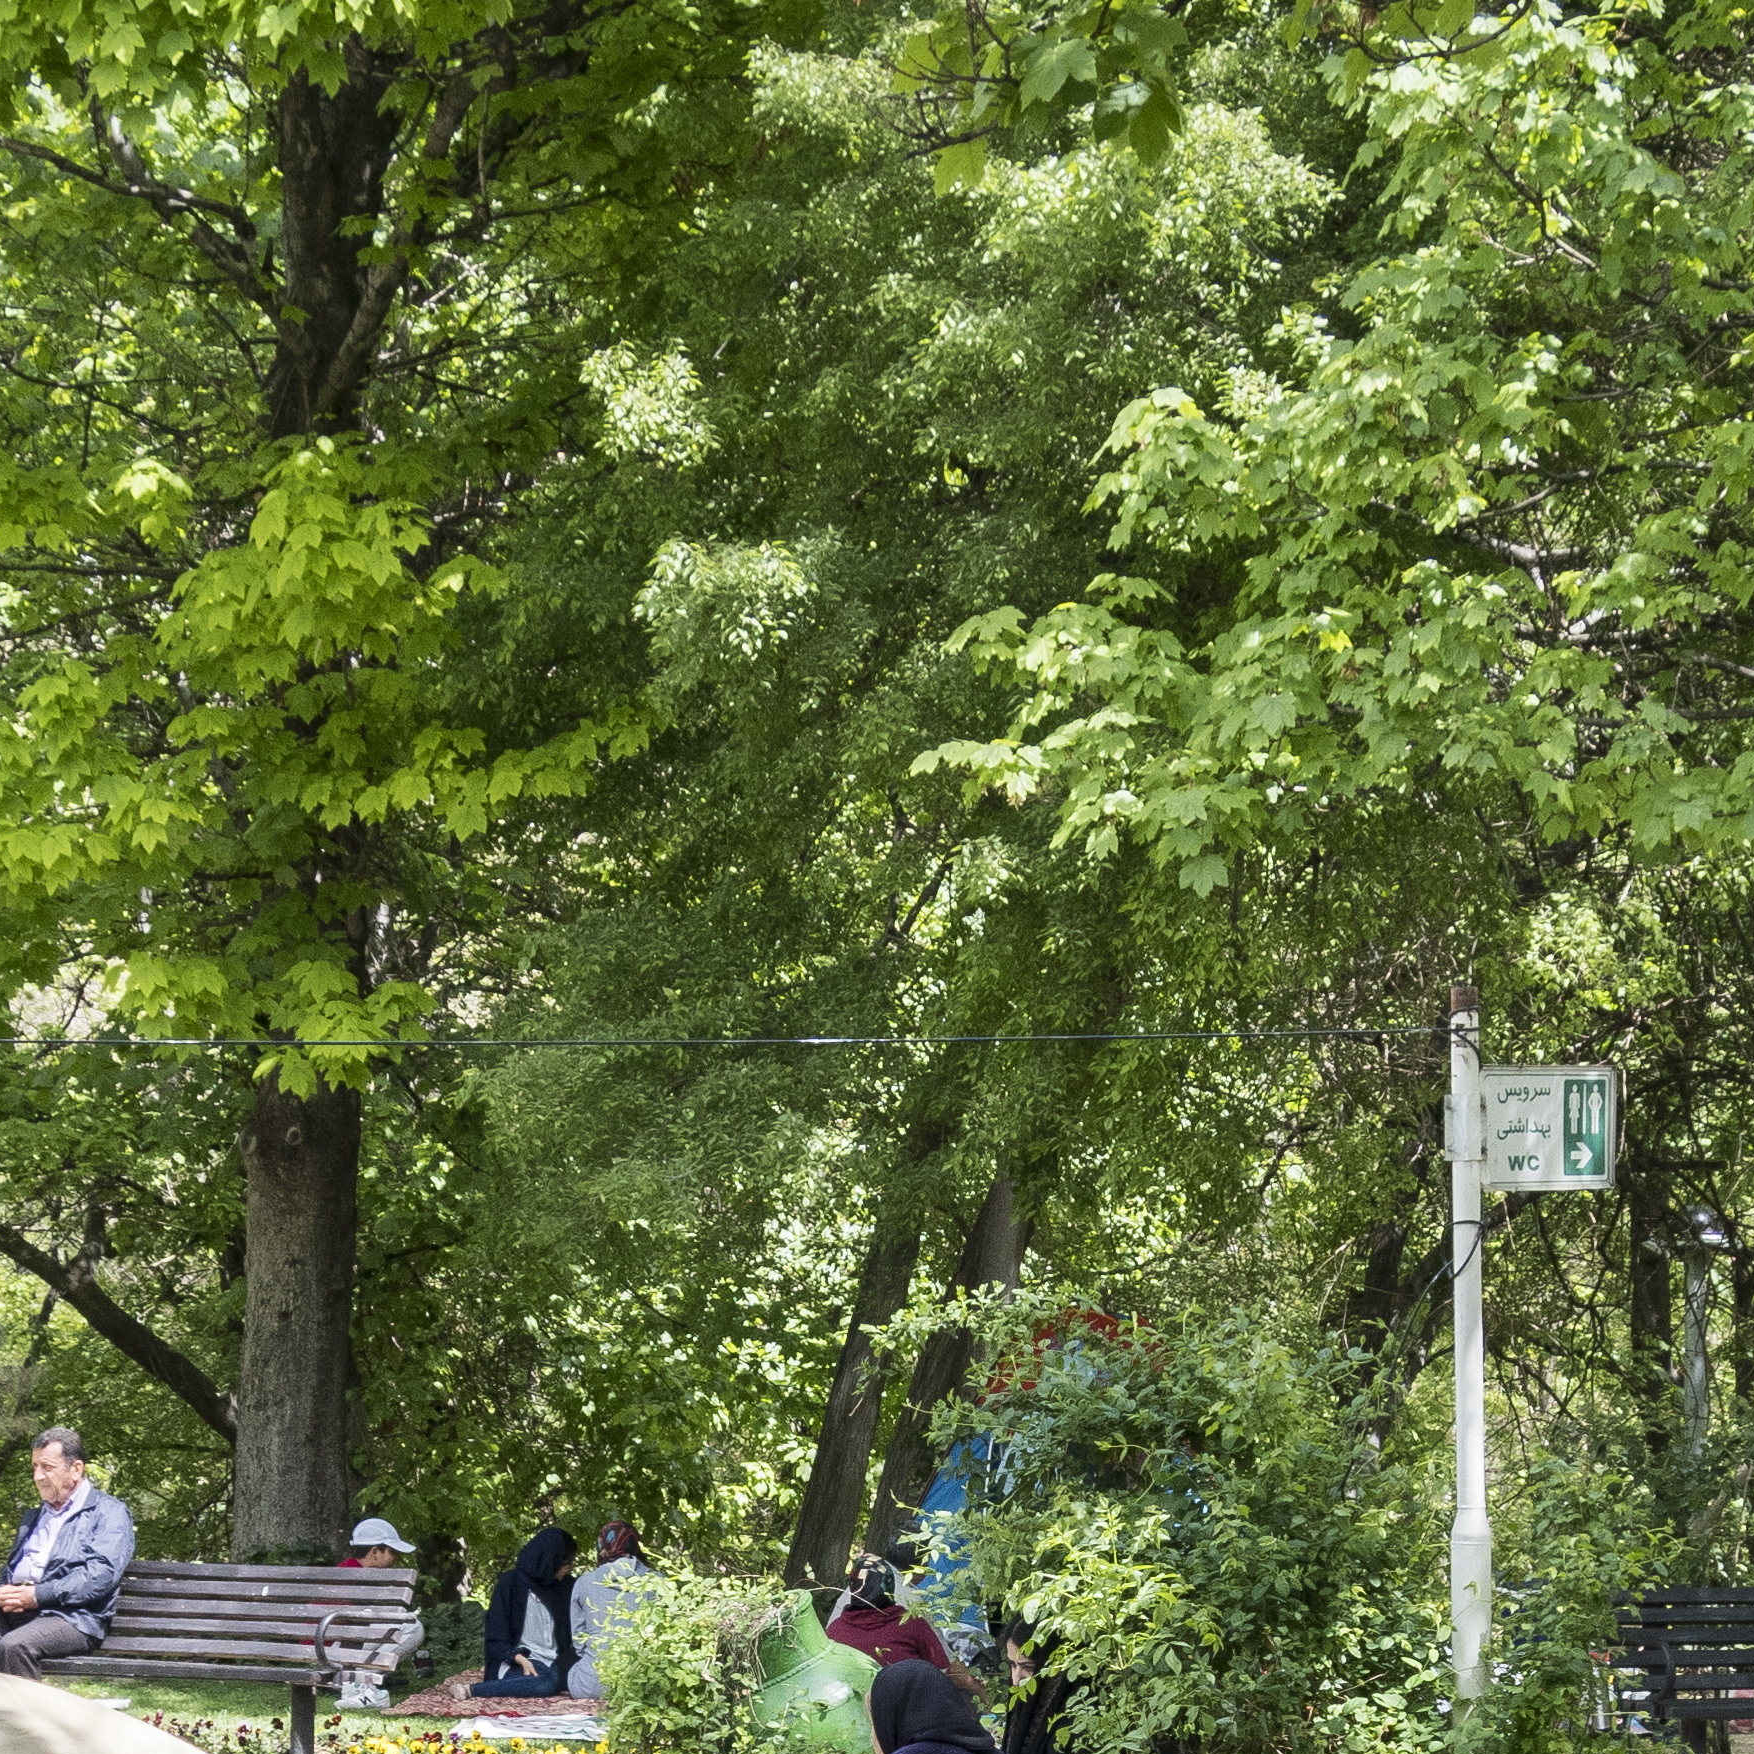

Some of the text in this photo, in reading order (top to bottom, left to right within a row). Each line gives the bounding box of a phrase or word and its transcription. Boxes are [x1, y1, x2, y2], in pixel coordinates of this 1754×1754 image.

[1497, 1086, 1551, 1104] سرویس
[1497, 1117, 1551, 1140] بهداشتی
[1507, 1154, 1540, 1171] WC
